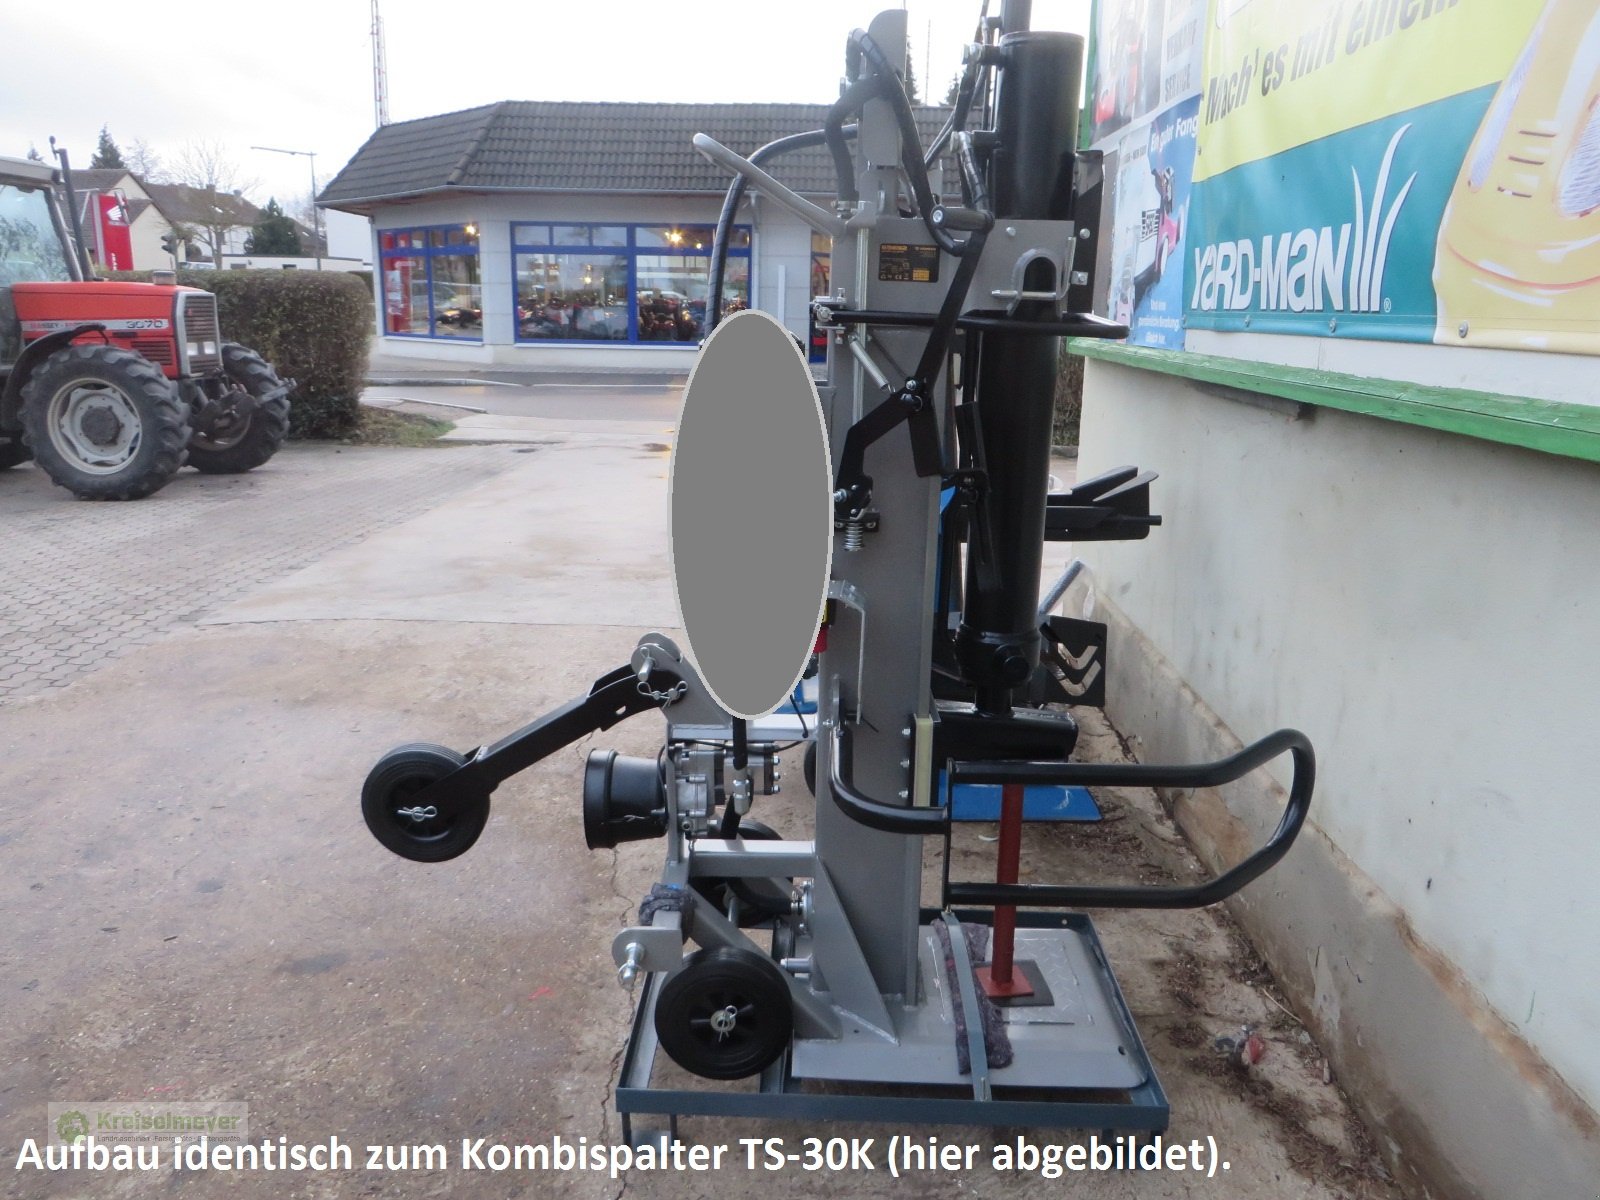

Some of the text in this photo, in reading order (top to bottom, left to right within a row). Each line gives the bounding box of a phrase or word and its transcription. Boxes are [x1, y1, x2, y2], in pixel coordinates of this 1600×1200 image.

[1205, 47, 1259, 126] Mach'
[1261, 43, 1288, 97] es
[1290, 4, 1344, 82] mit
[1176, 117, 1199, 138] Fang
